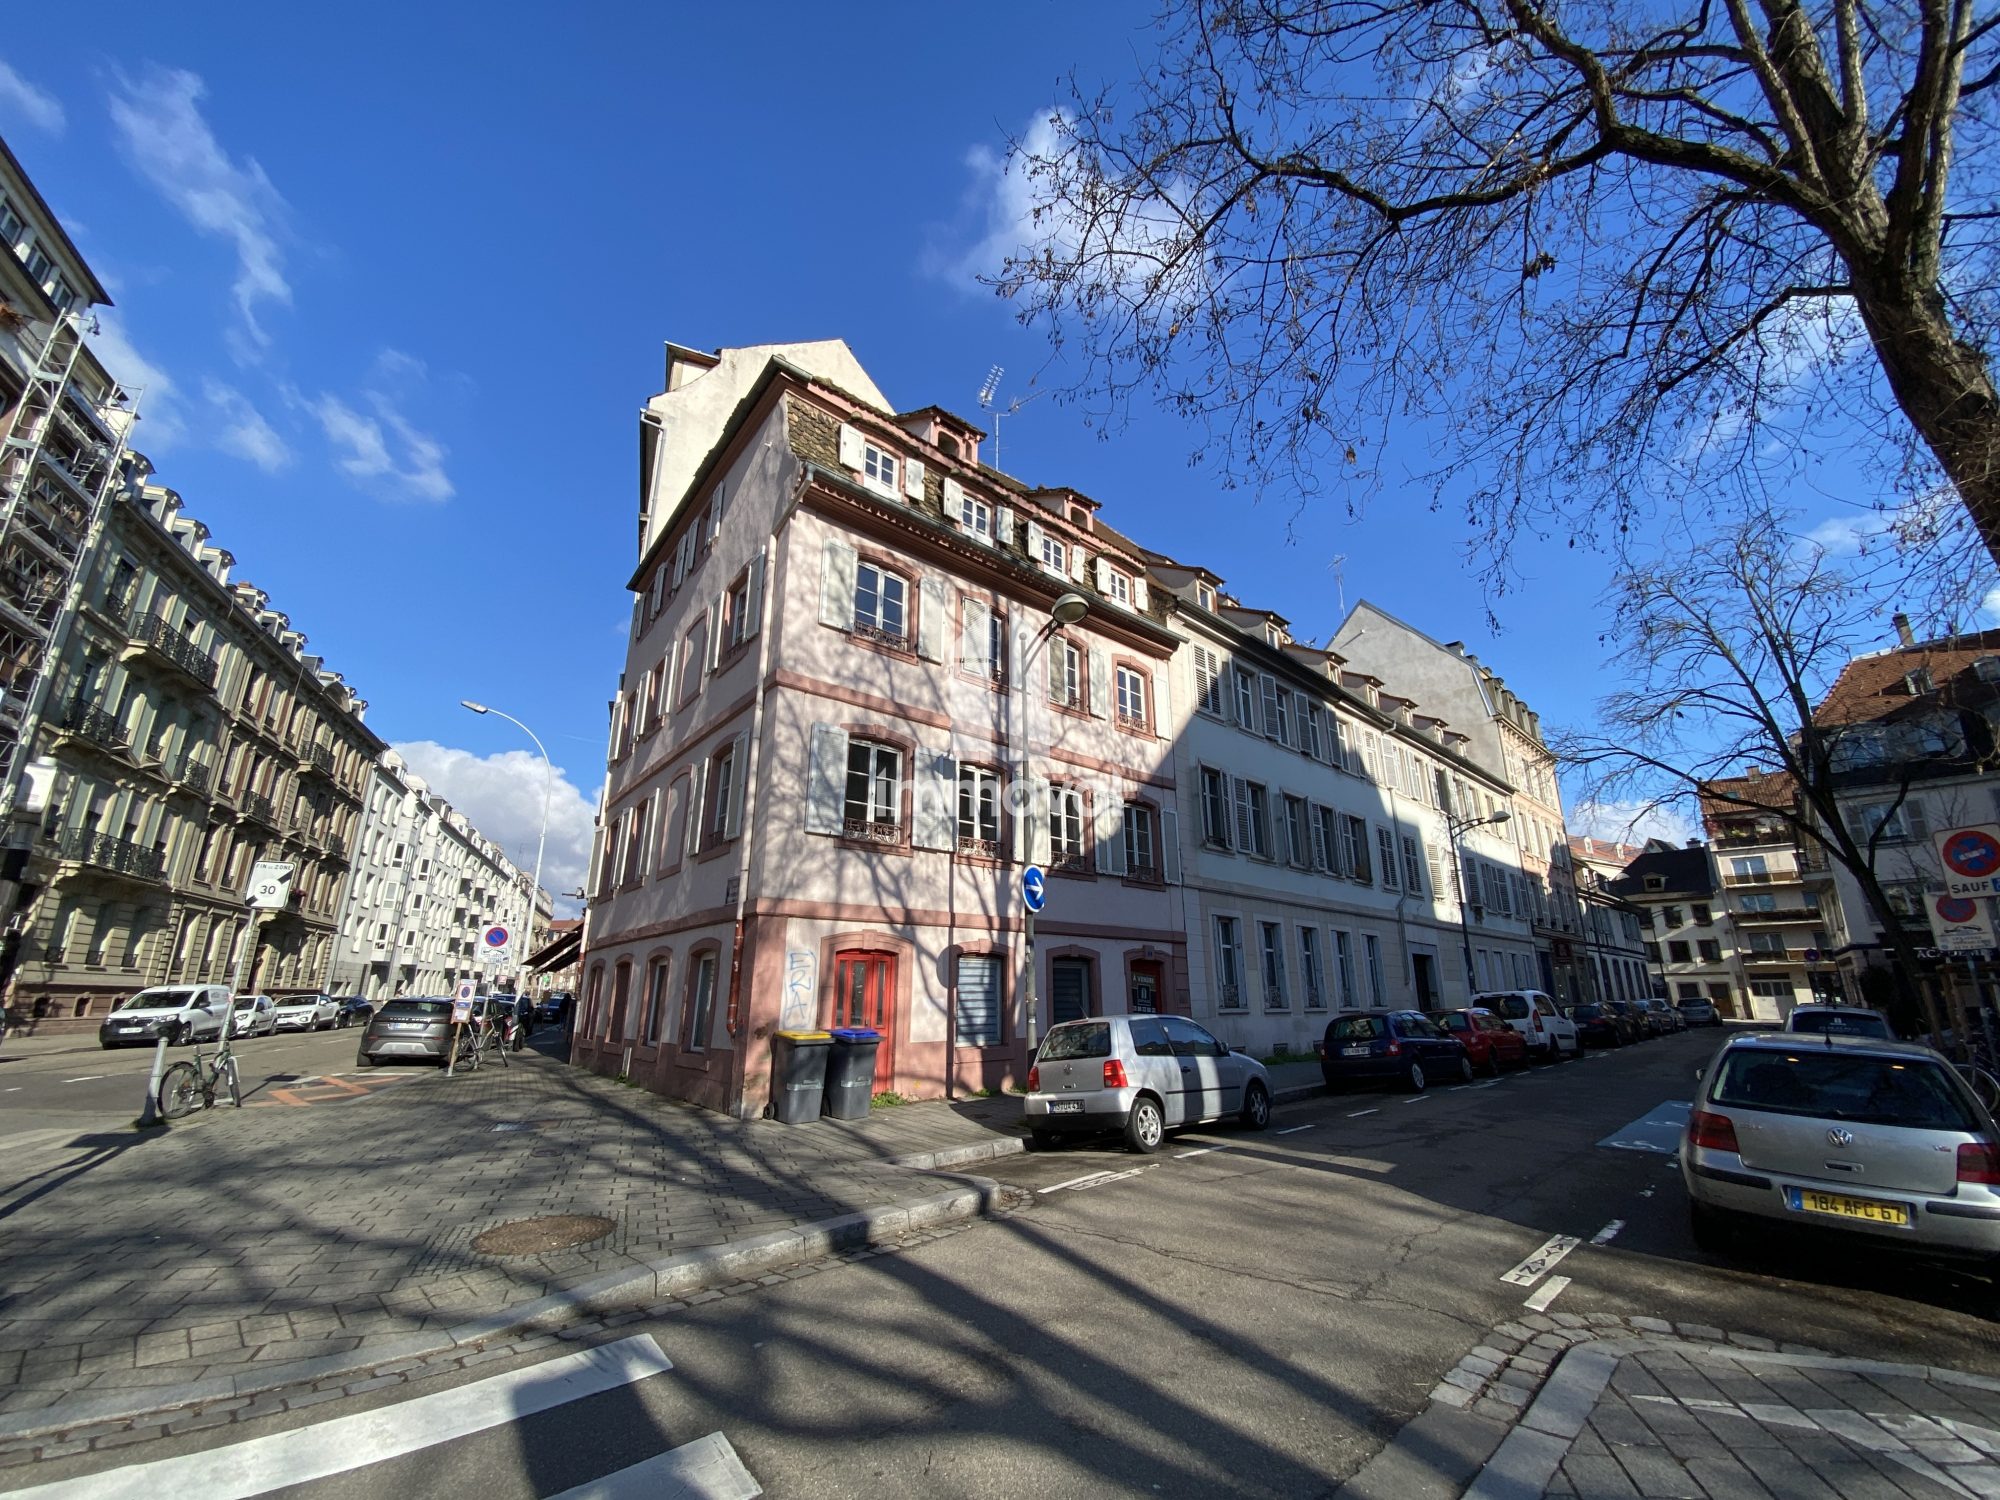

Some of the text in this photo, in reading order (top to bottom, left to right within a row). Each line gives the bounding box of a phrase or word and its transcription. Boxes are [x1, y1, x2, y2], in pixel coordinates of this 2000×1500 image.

[260, 885, 276, 895] 30
[1951, 881, 1990, 894] SAUF
[1811, 1195, 1901, 1221] 184 AFC 67
